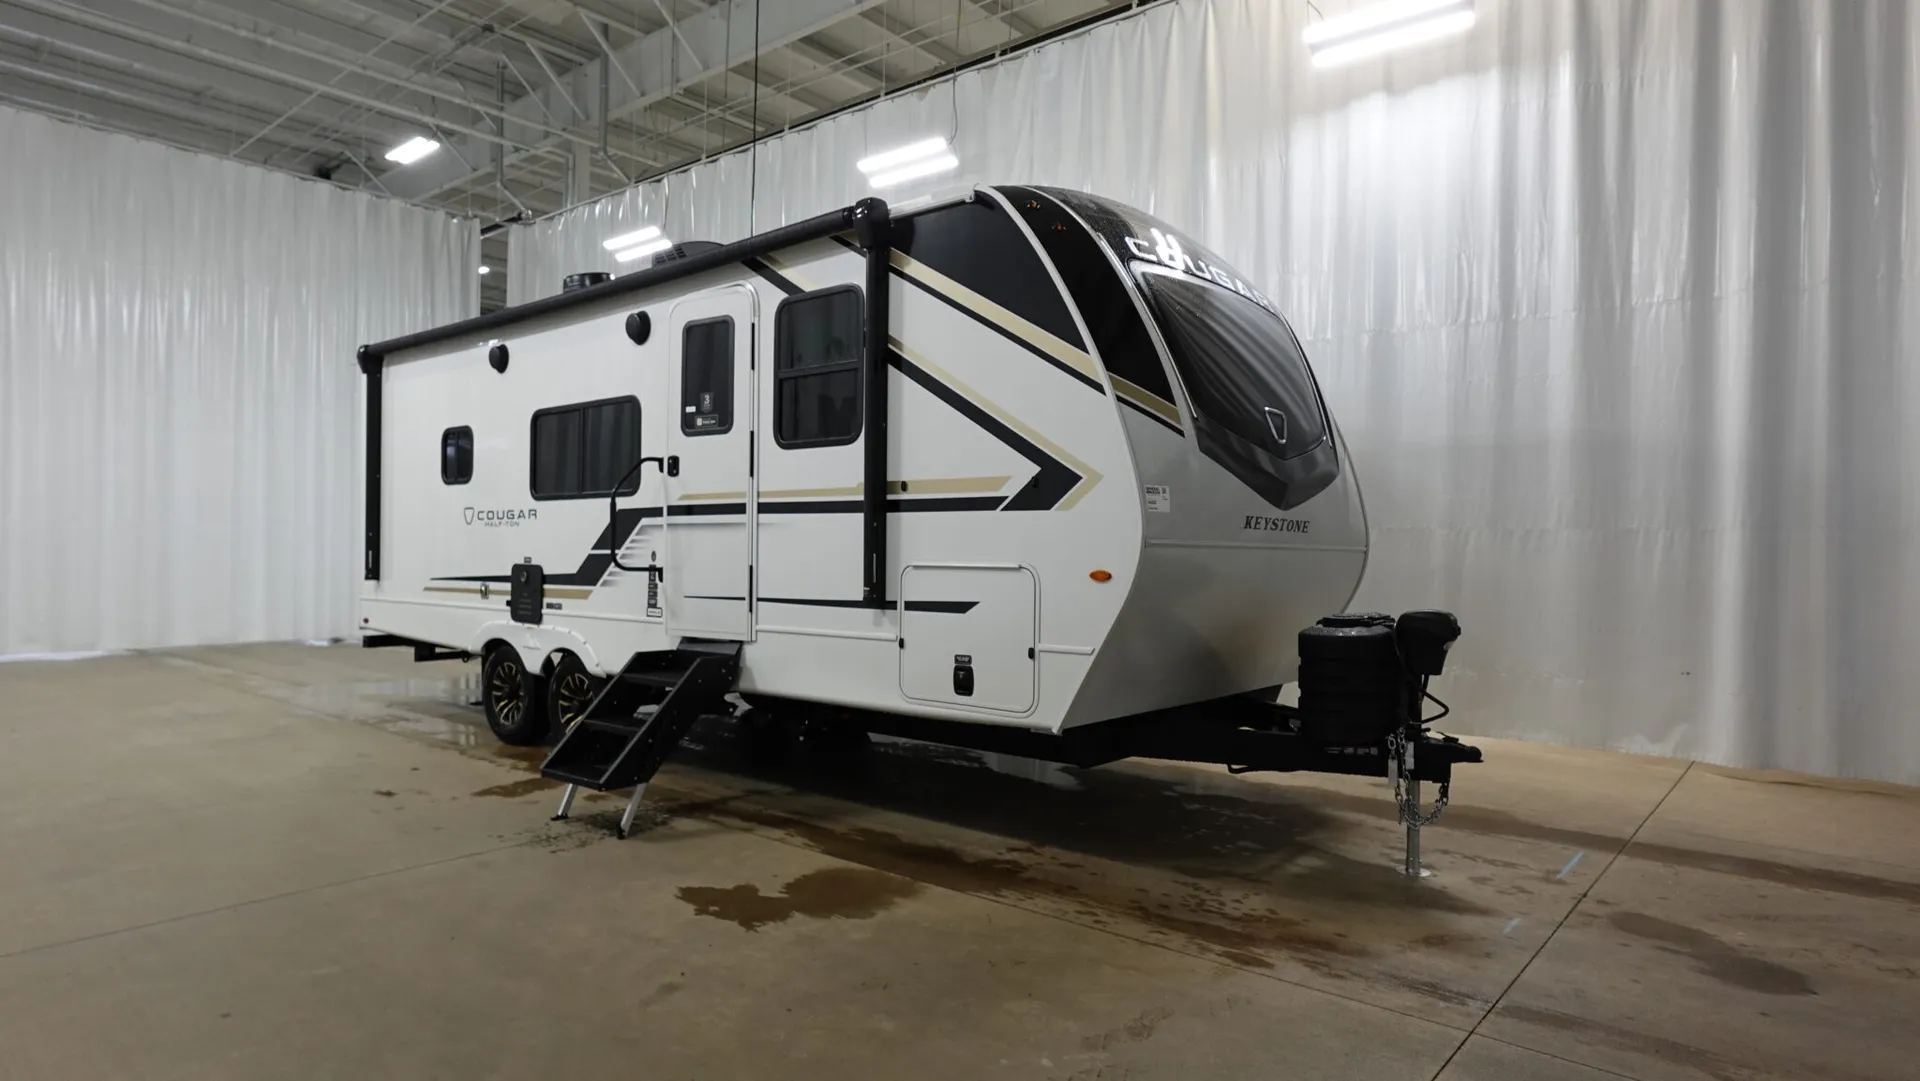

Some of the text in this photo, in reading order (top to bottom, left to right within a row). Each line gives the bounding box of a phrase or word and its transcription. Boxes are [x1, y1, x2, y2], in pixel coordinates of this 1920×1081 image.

[703, 394, 711, 405] 3
[477, 509, 538, 521] COUGAR
[1243, 515, 1311, 534] KEYSTONE
